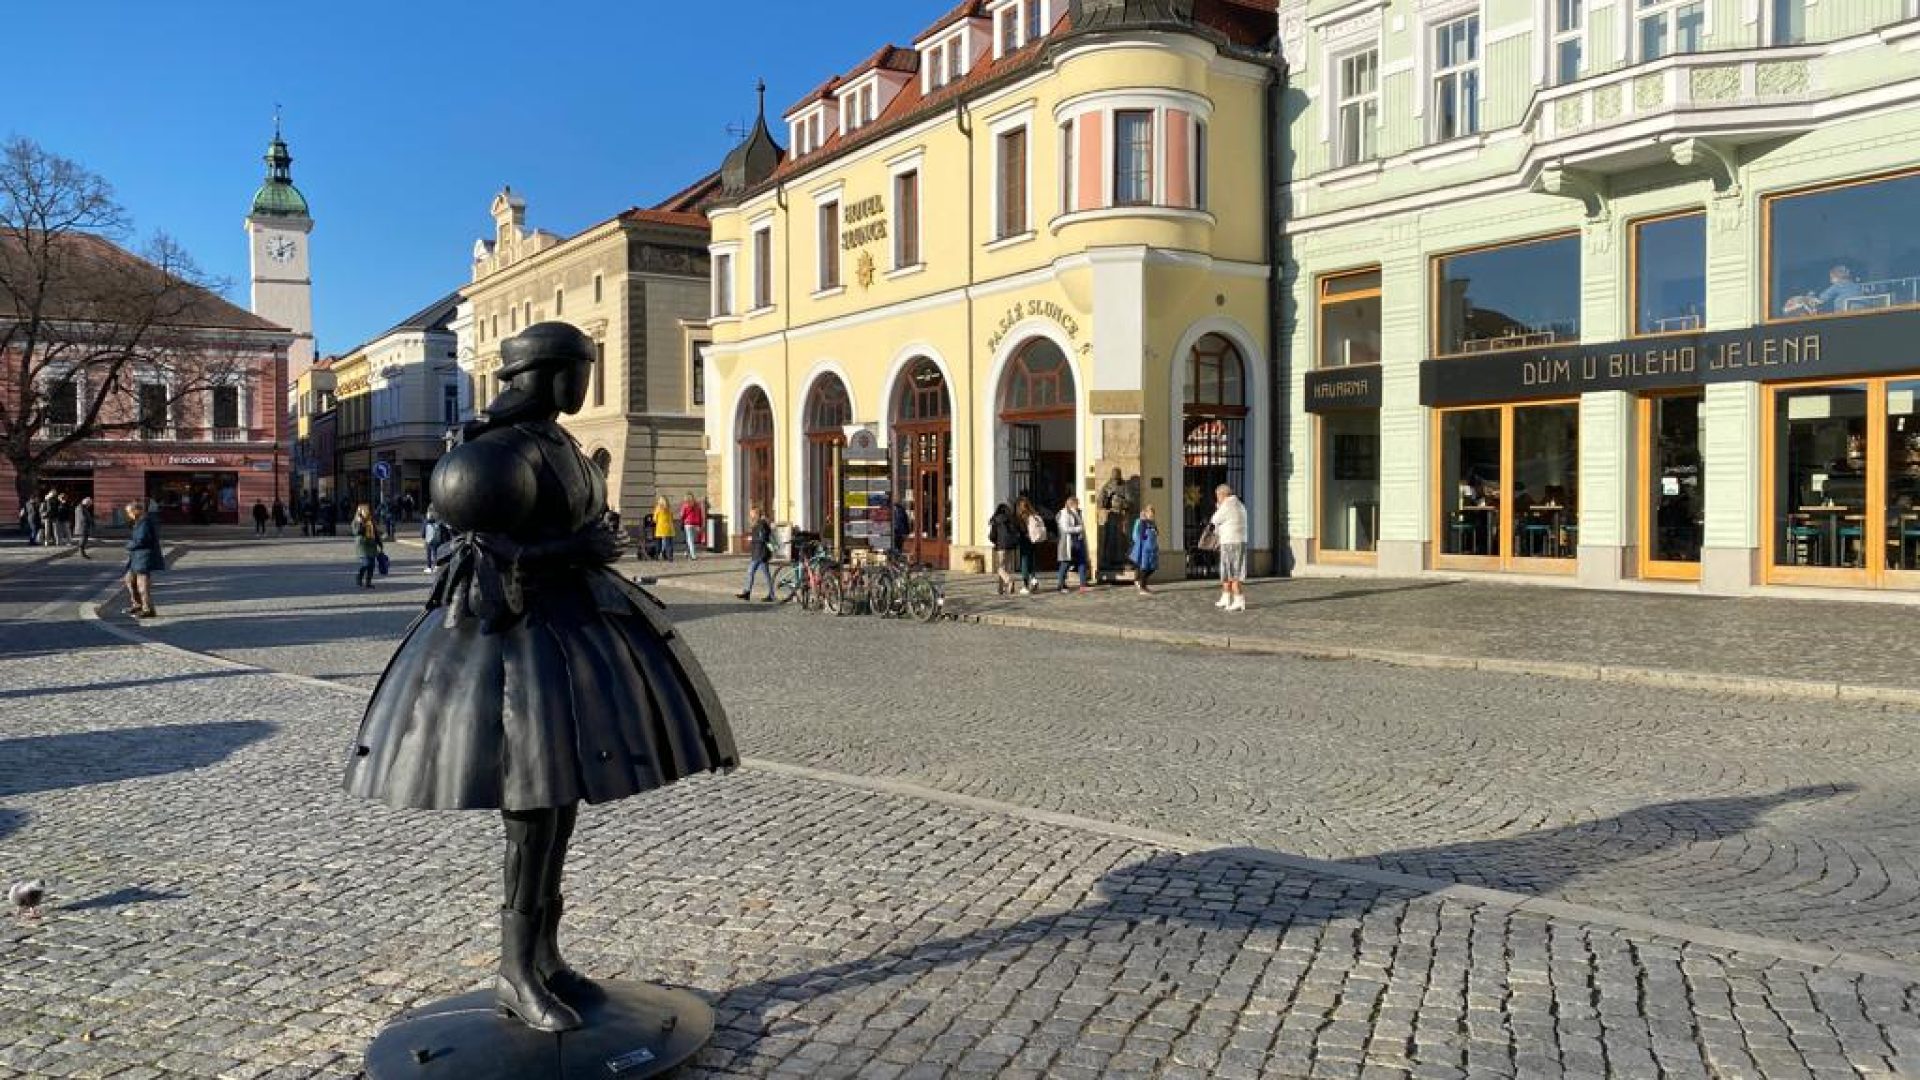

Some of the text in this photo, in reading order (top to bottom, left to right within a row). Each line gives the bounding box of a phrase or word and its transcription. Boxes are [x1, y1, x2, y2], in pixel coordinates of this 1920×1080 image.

[1026, 299, 1079, 340] SLUNCE
[1583, 356, 1597, 380] U
[1709, 334, 1821, 371] JELENA
